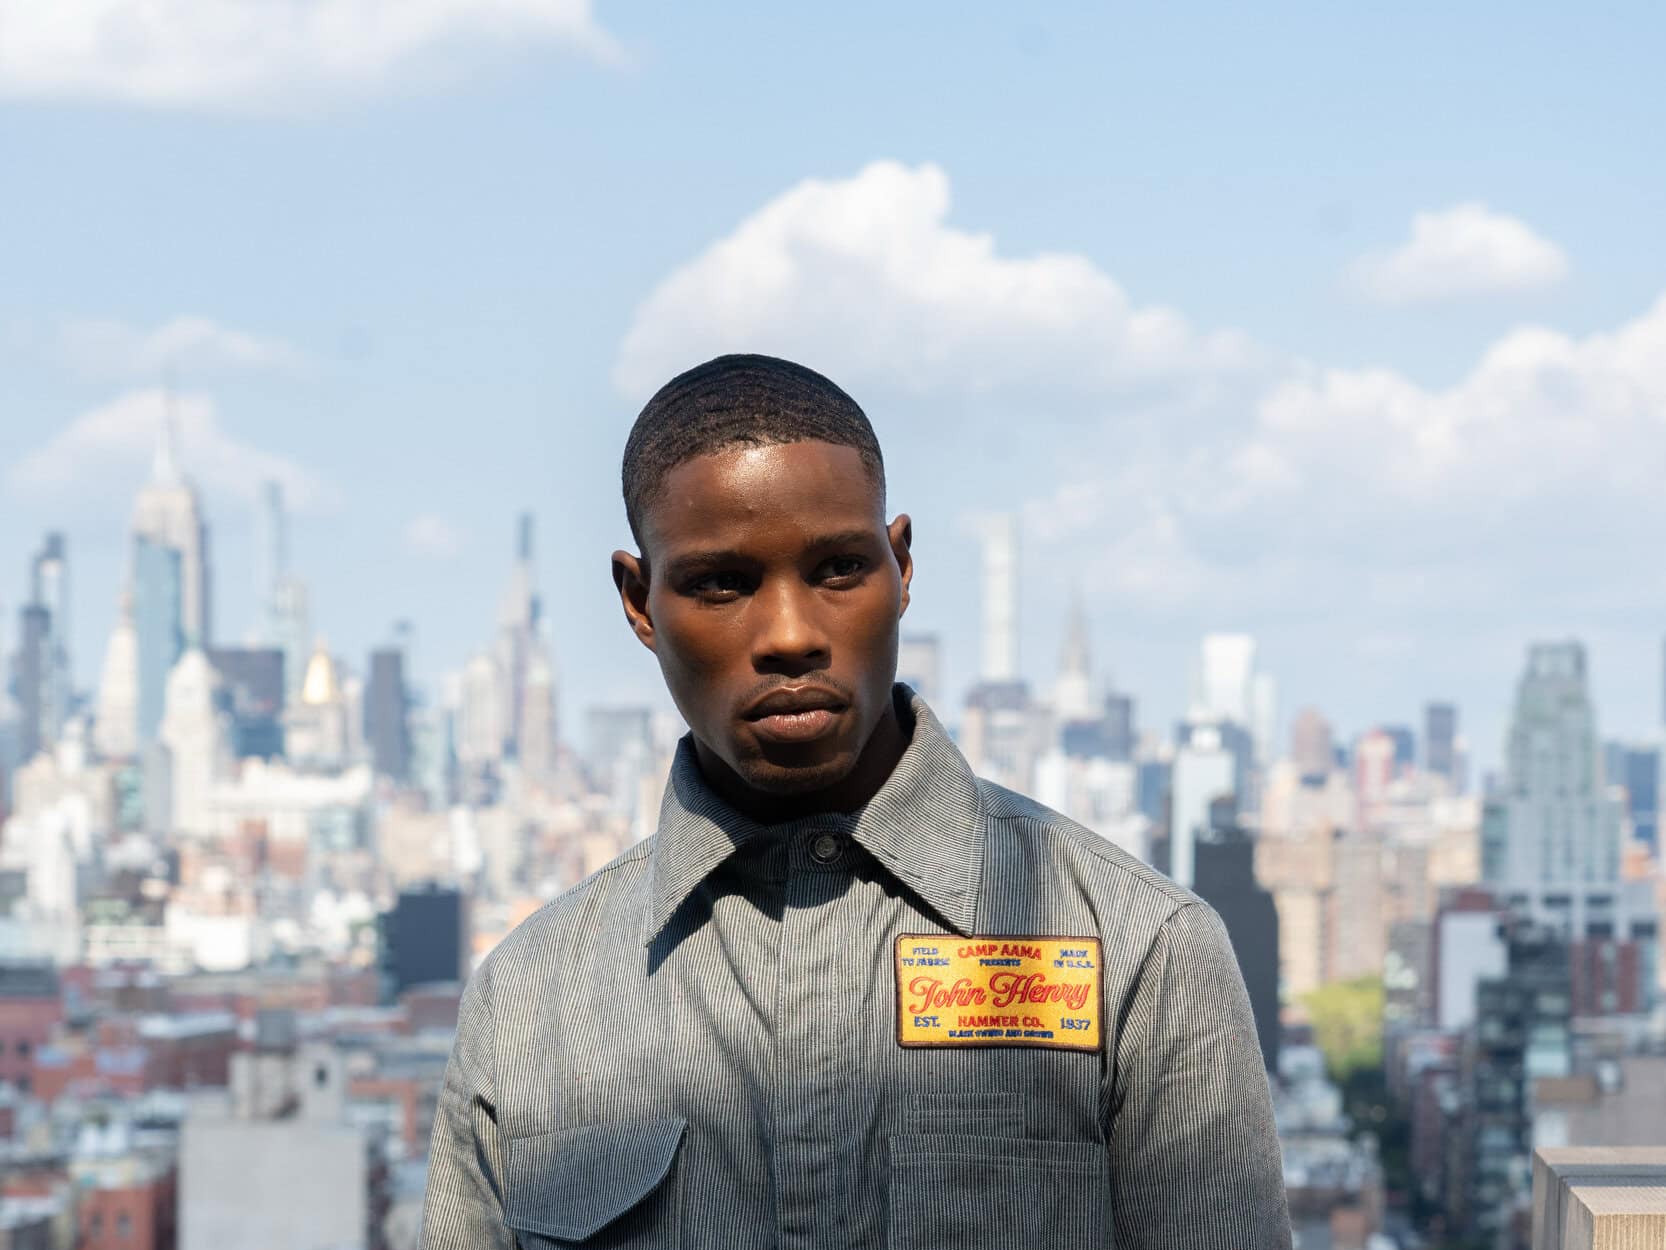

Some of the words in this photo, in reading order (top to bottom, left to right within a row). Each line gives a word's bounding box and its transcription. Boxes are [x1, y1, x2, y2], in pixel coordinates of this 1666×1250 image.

[958, 943, 998, 959] CAMP
[1001, 943, 1042, 960] AAMA
[908, 976, 987, 1014] John
[989, 972, 1091, 1010] Henry
[913, 1015, 940, 1028] EST.
[958, 1015, 1019, 1028] HAMMER
[1022, 1016, 1045, 1028] CO.
[1060, 1016, 1091, 1030] 1937
